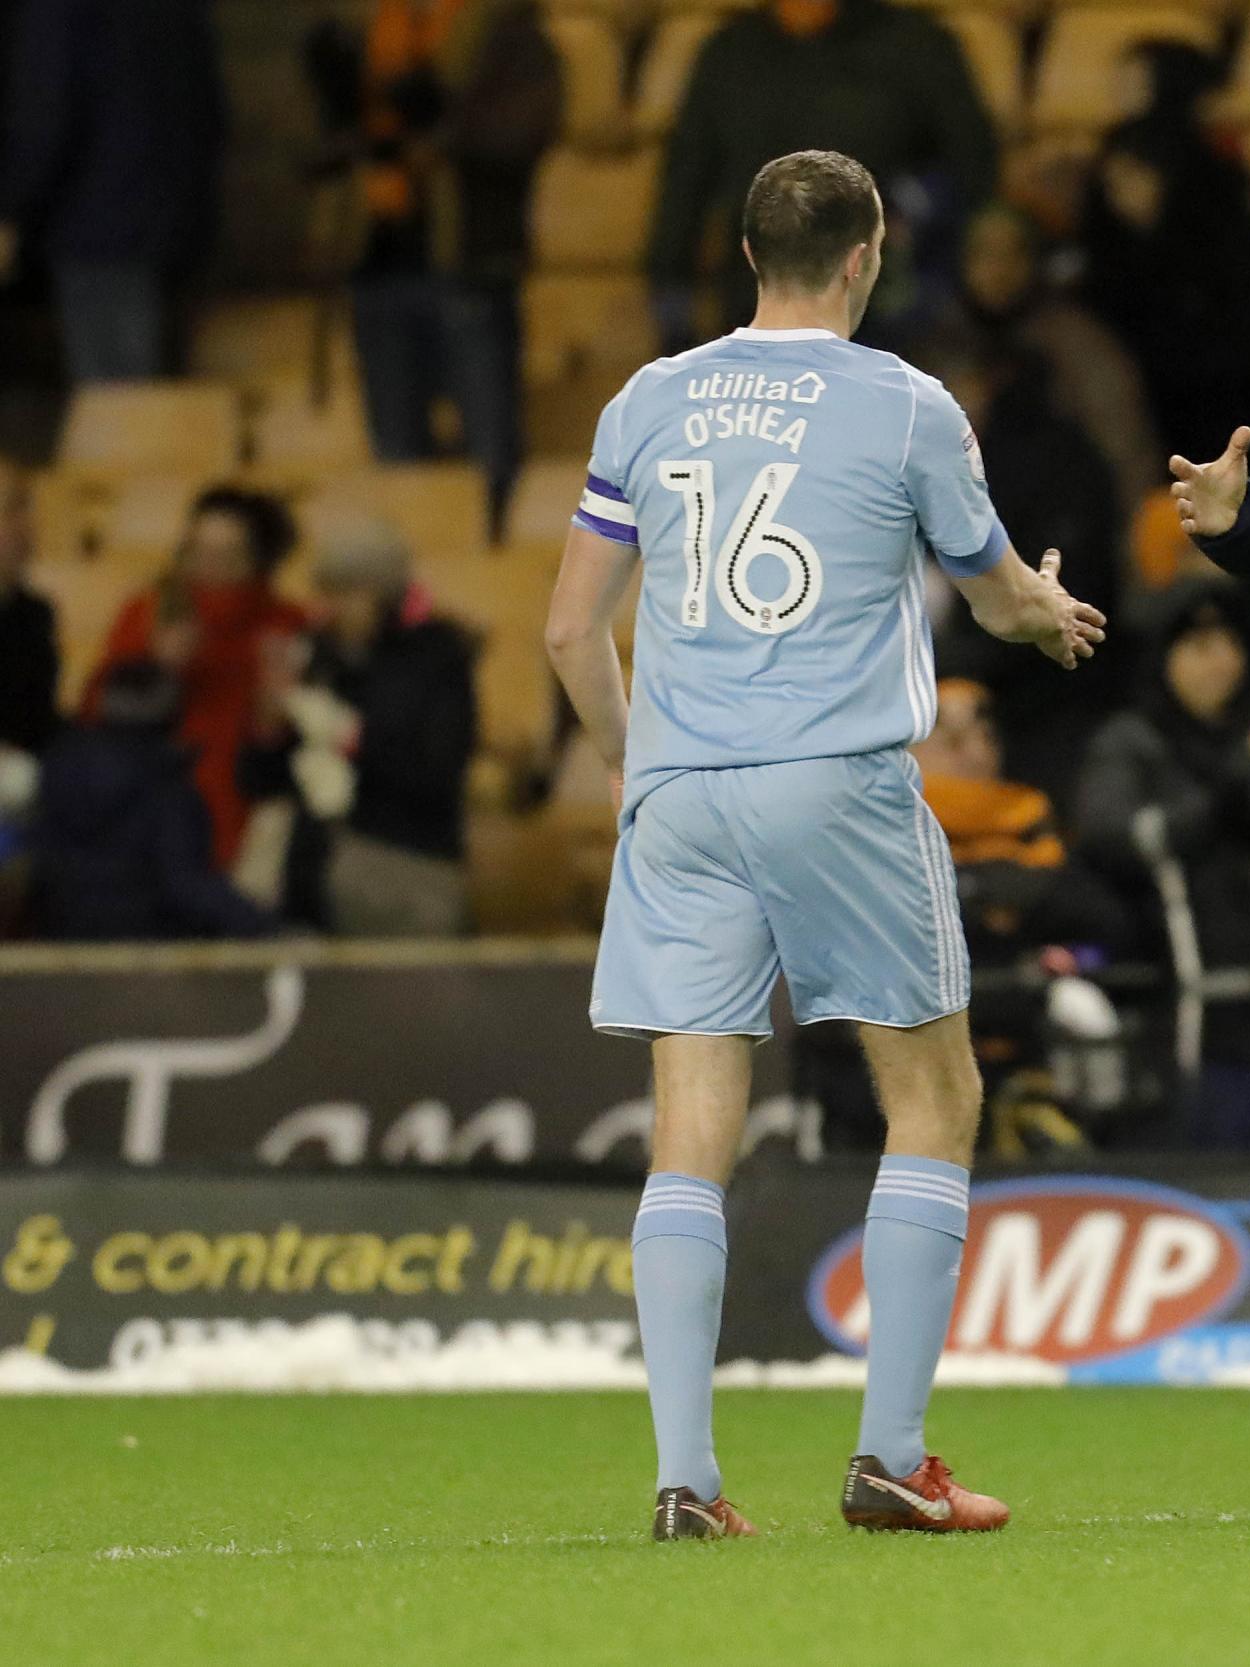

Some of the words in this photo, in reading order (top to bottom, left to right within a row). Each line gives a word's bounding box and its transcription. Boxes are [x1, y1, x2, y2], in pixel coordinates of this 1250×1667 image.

[688, 372, 788, 400] utilita
[684, 403, 808, 454] O'SHEA
[658, 460, 823, 635] 16
[91, 1222, 473, 1296] contract
[842, 1211, 1220, 1350] MP
